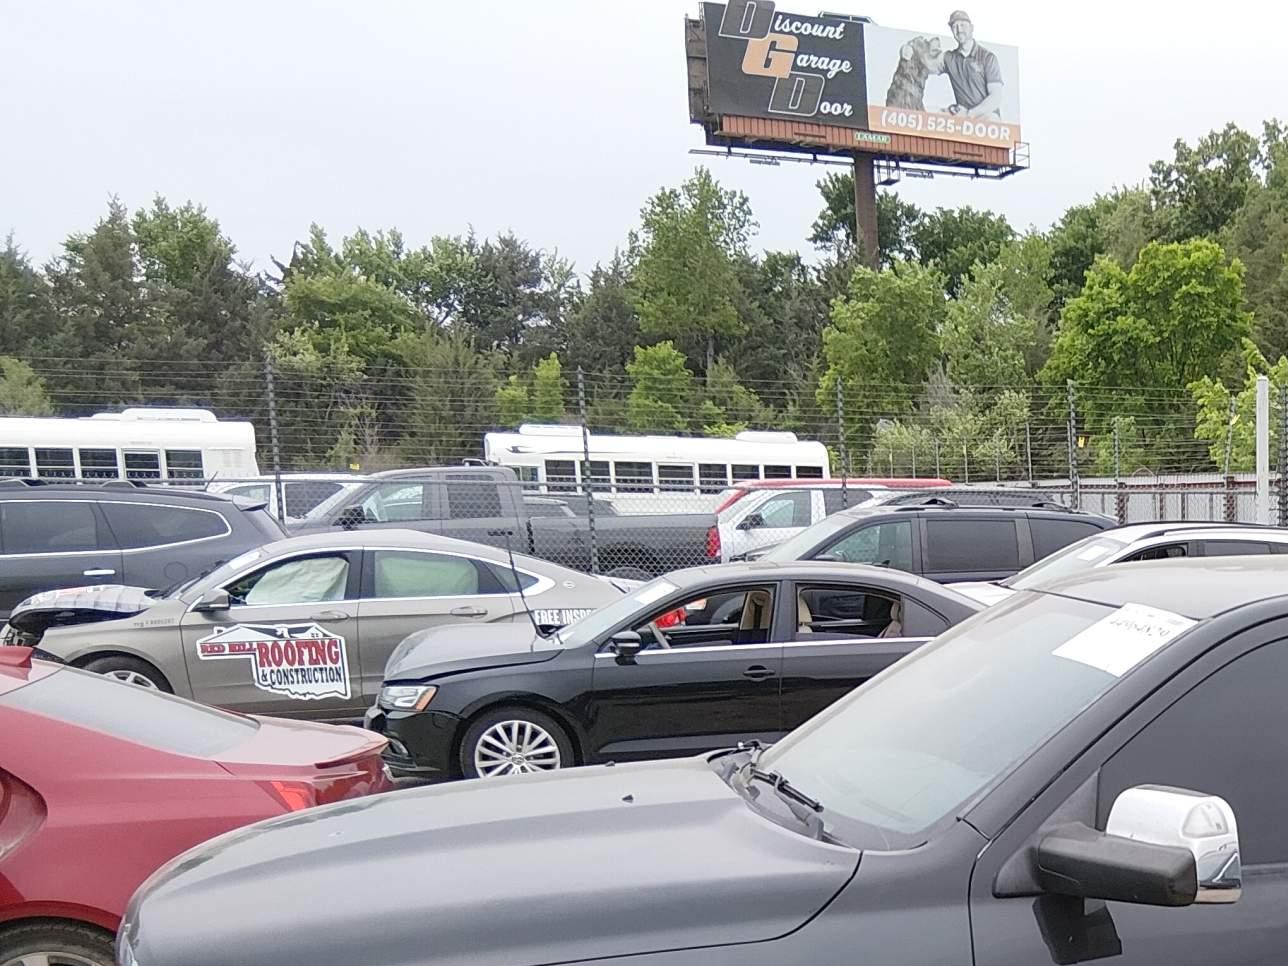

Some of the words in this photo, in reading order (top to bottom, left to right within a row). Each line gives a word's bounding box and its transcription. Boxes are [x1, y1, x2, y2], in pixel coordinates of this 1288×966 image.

[718, 0, 845, 41] Discount
[741, 32, 853, 79] Garage
[768, 71, 853, 117] Door
[881, 109, 922, 131] (405)
[927, 117, 1010, 141] 525-DOOR
[533, 609, 560, 625] FREE
[257, 640, 340, 668] ROOFING
[261, 668, 268, 682] &
[269, 666, 343, 685] CONSTRUCTION
